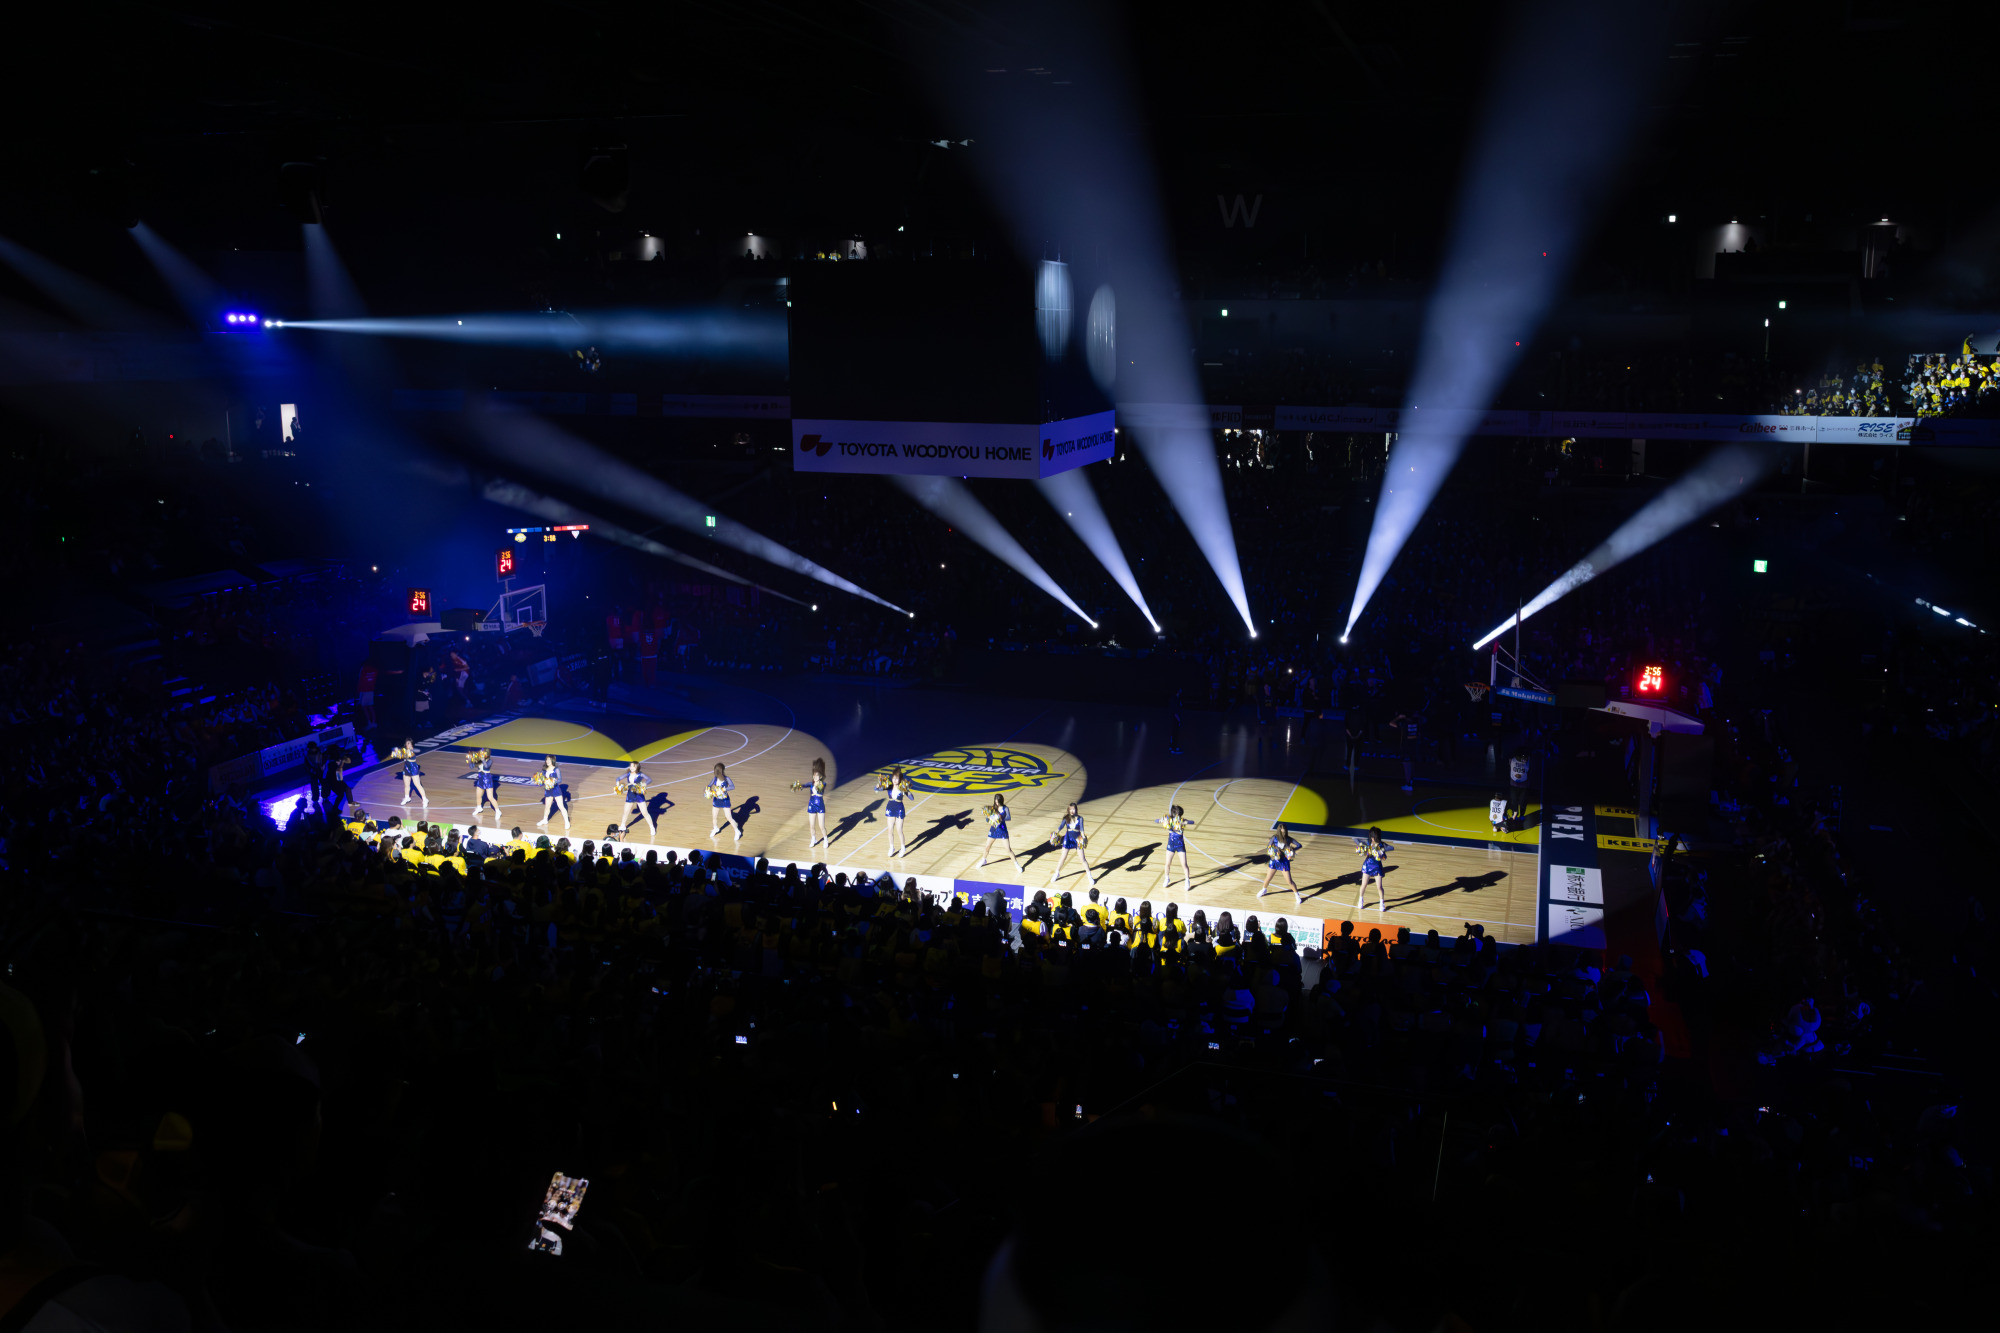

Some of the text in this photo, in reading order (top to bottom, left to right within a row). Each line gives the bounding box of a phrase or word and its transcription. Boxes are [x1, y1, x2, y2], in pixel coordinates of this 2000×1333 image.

[1216, 193, 1264, 228] W
[1739, 422, 1777, 434] Calbee
[1858, 423, 1896, 433] RISE
[1056, 440, 1076, 456] TOYOTA
[1100, 430, 1114, 444] HOME
[838, 442, 1032, 461] TOYOTA WOODYOU HOME
[500, 559, 512, 573] 24
[412, 599, 426, 611] 24
[1644, 665, 1662, 676] 3:56
[1640, 675, 1661, 691] 24
[1607, 839, 1654, 848] KEEP
